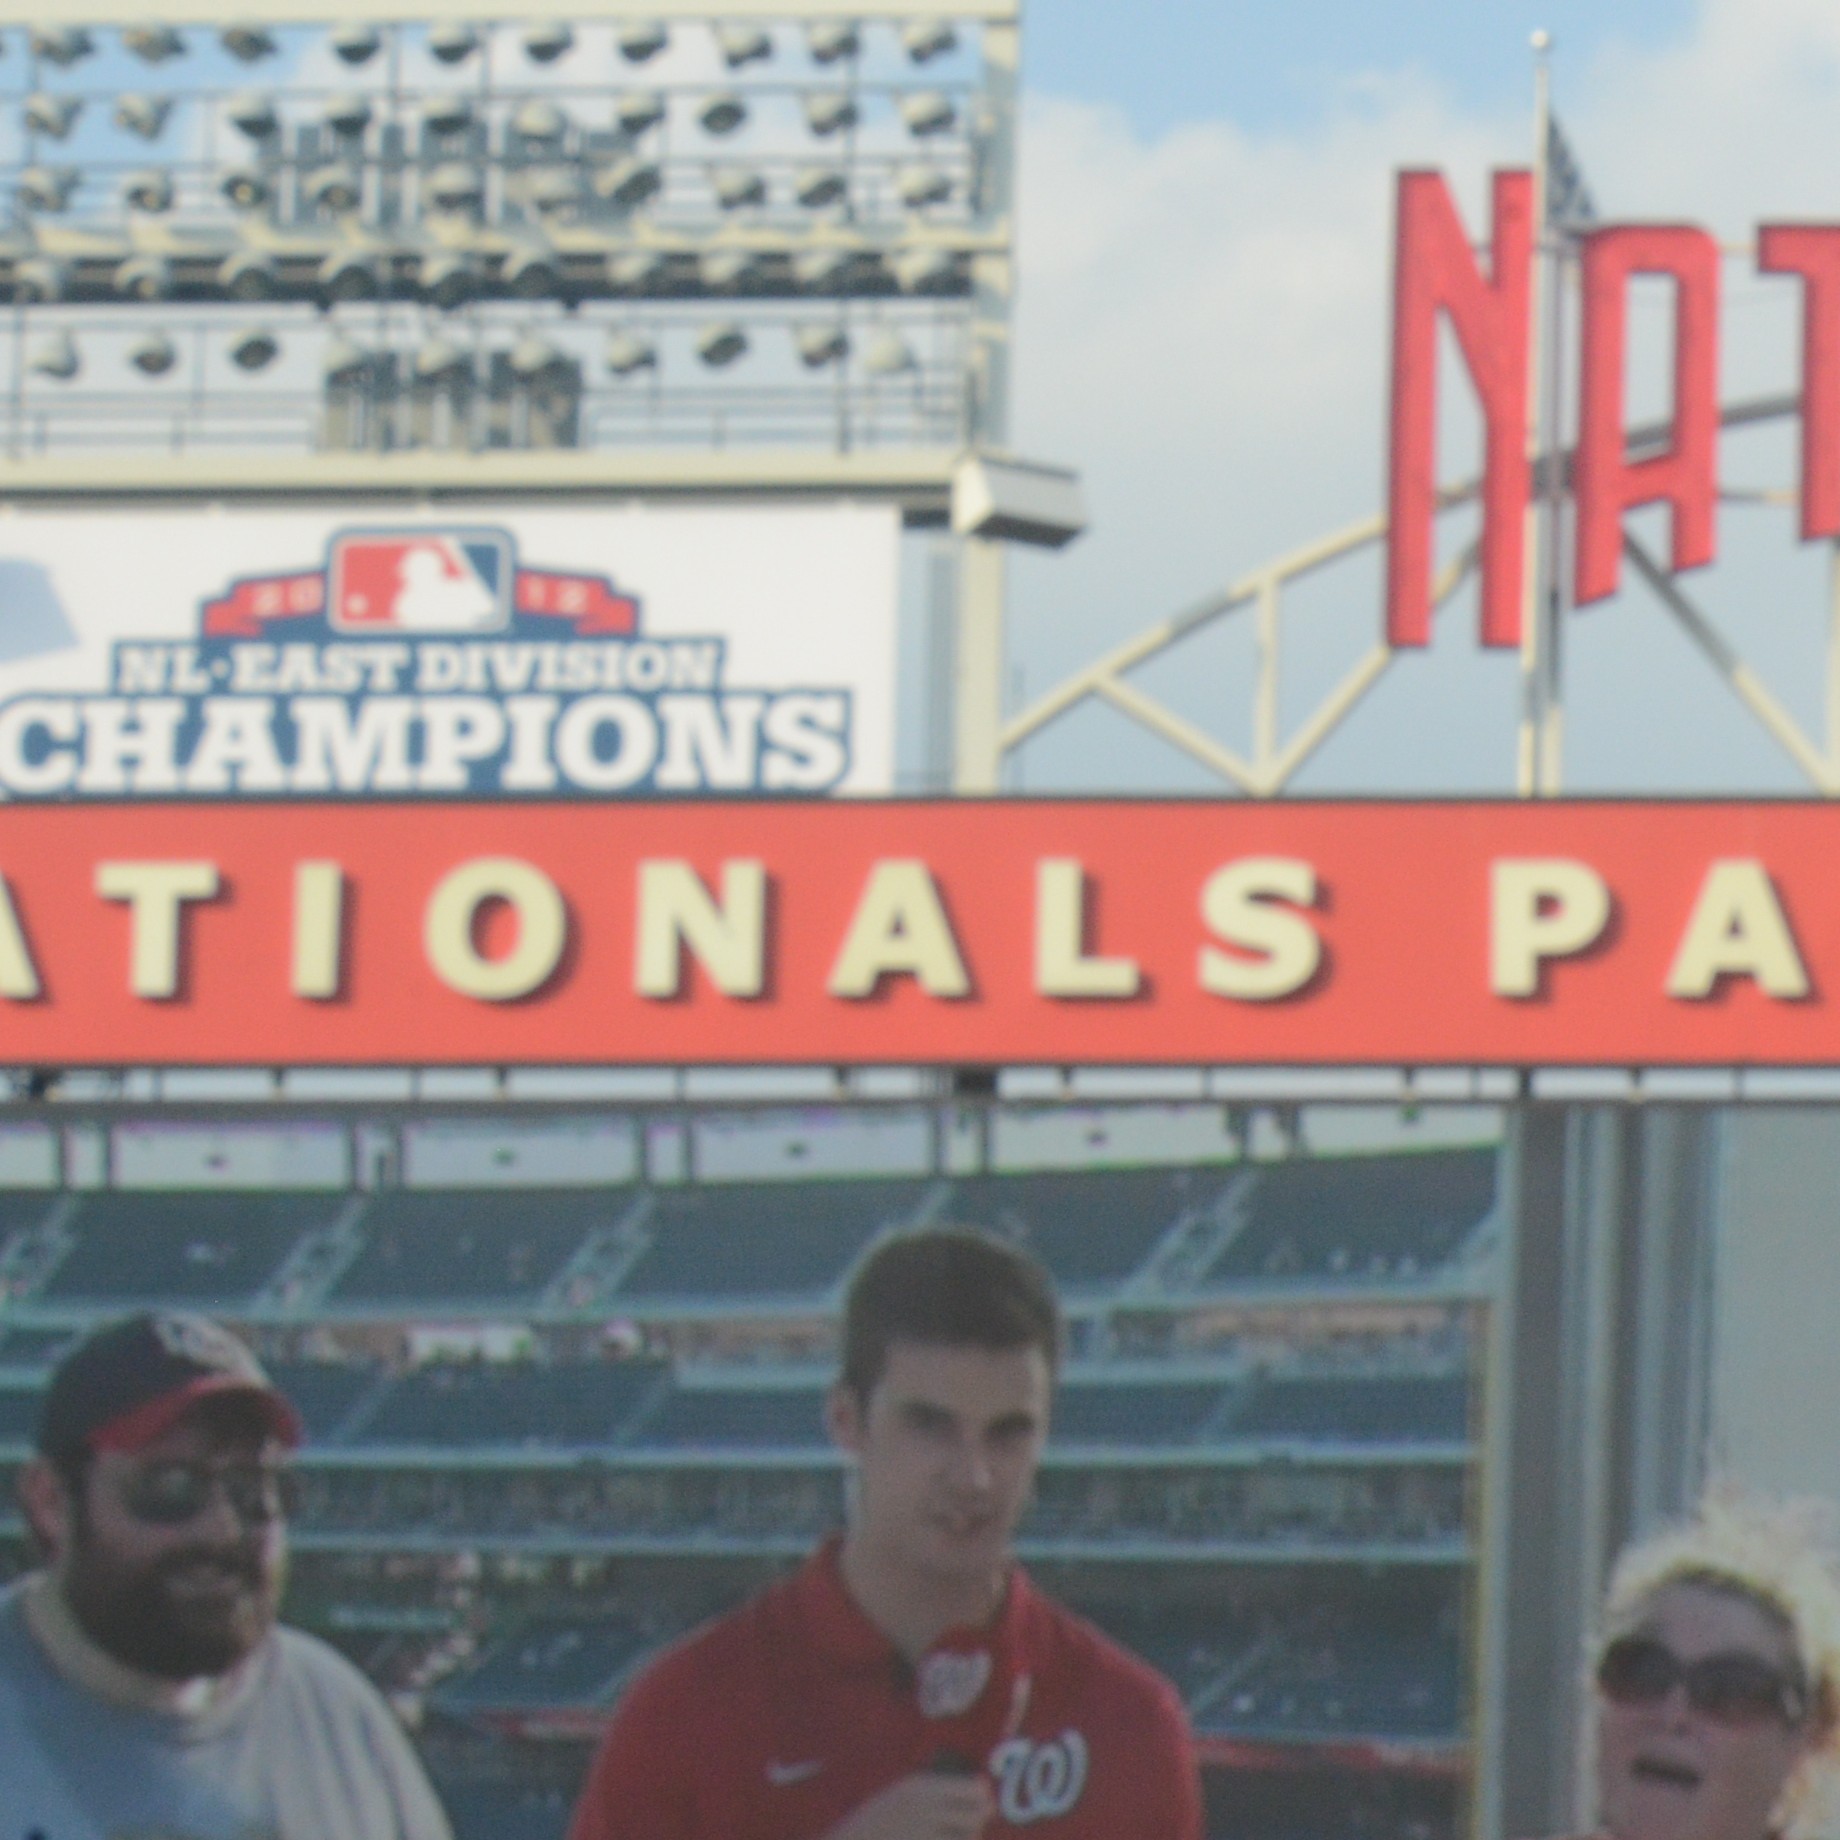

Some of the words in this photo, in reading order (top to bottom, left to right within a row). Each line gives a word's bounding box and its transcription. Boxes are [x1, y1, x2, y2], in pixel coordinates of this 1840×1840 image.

[415, 640, 721, 692] DIVISION
[1, 692, 848, 794] CHAMPIONS
[0, 856, 1325, 1001] TIONALS
